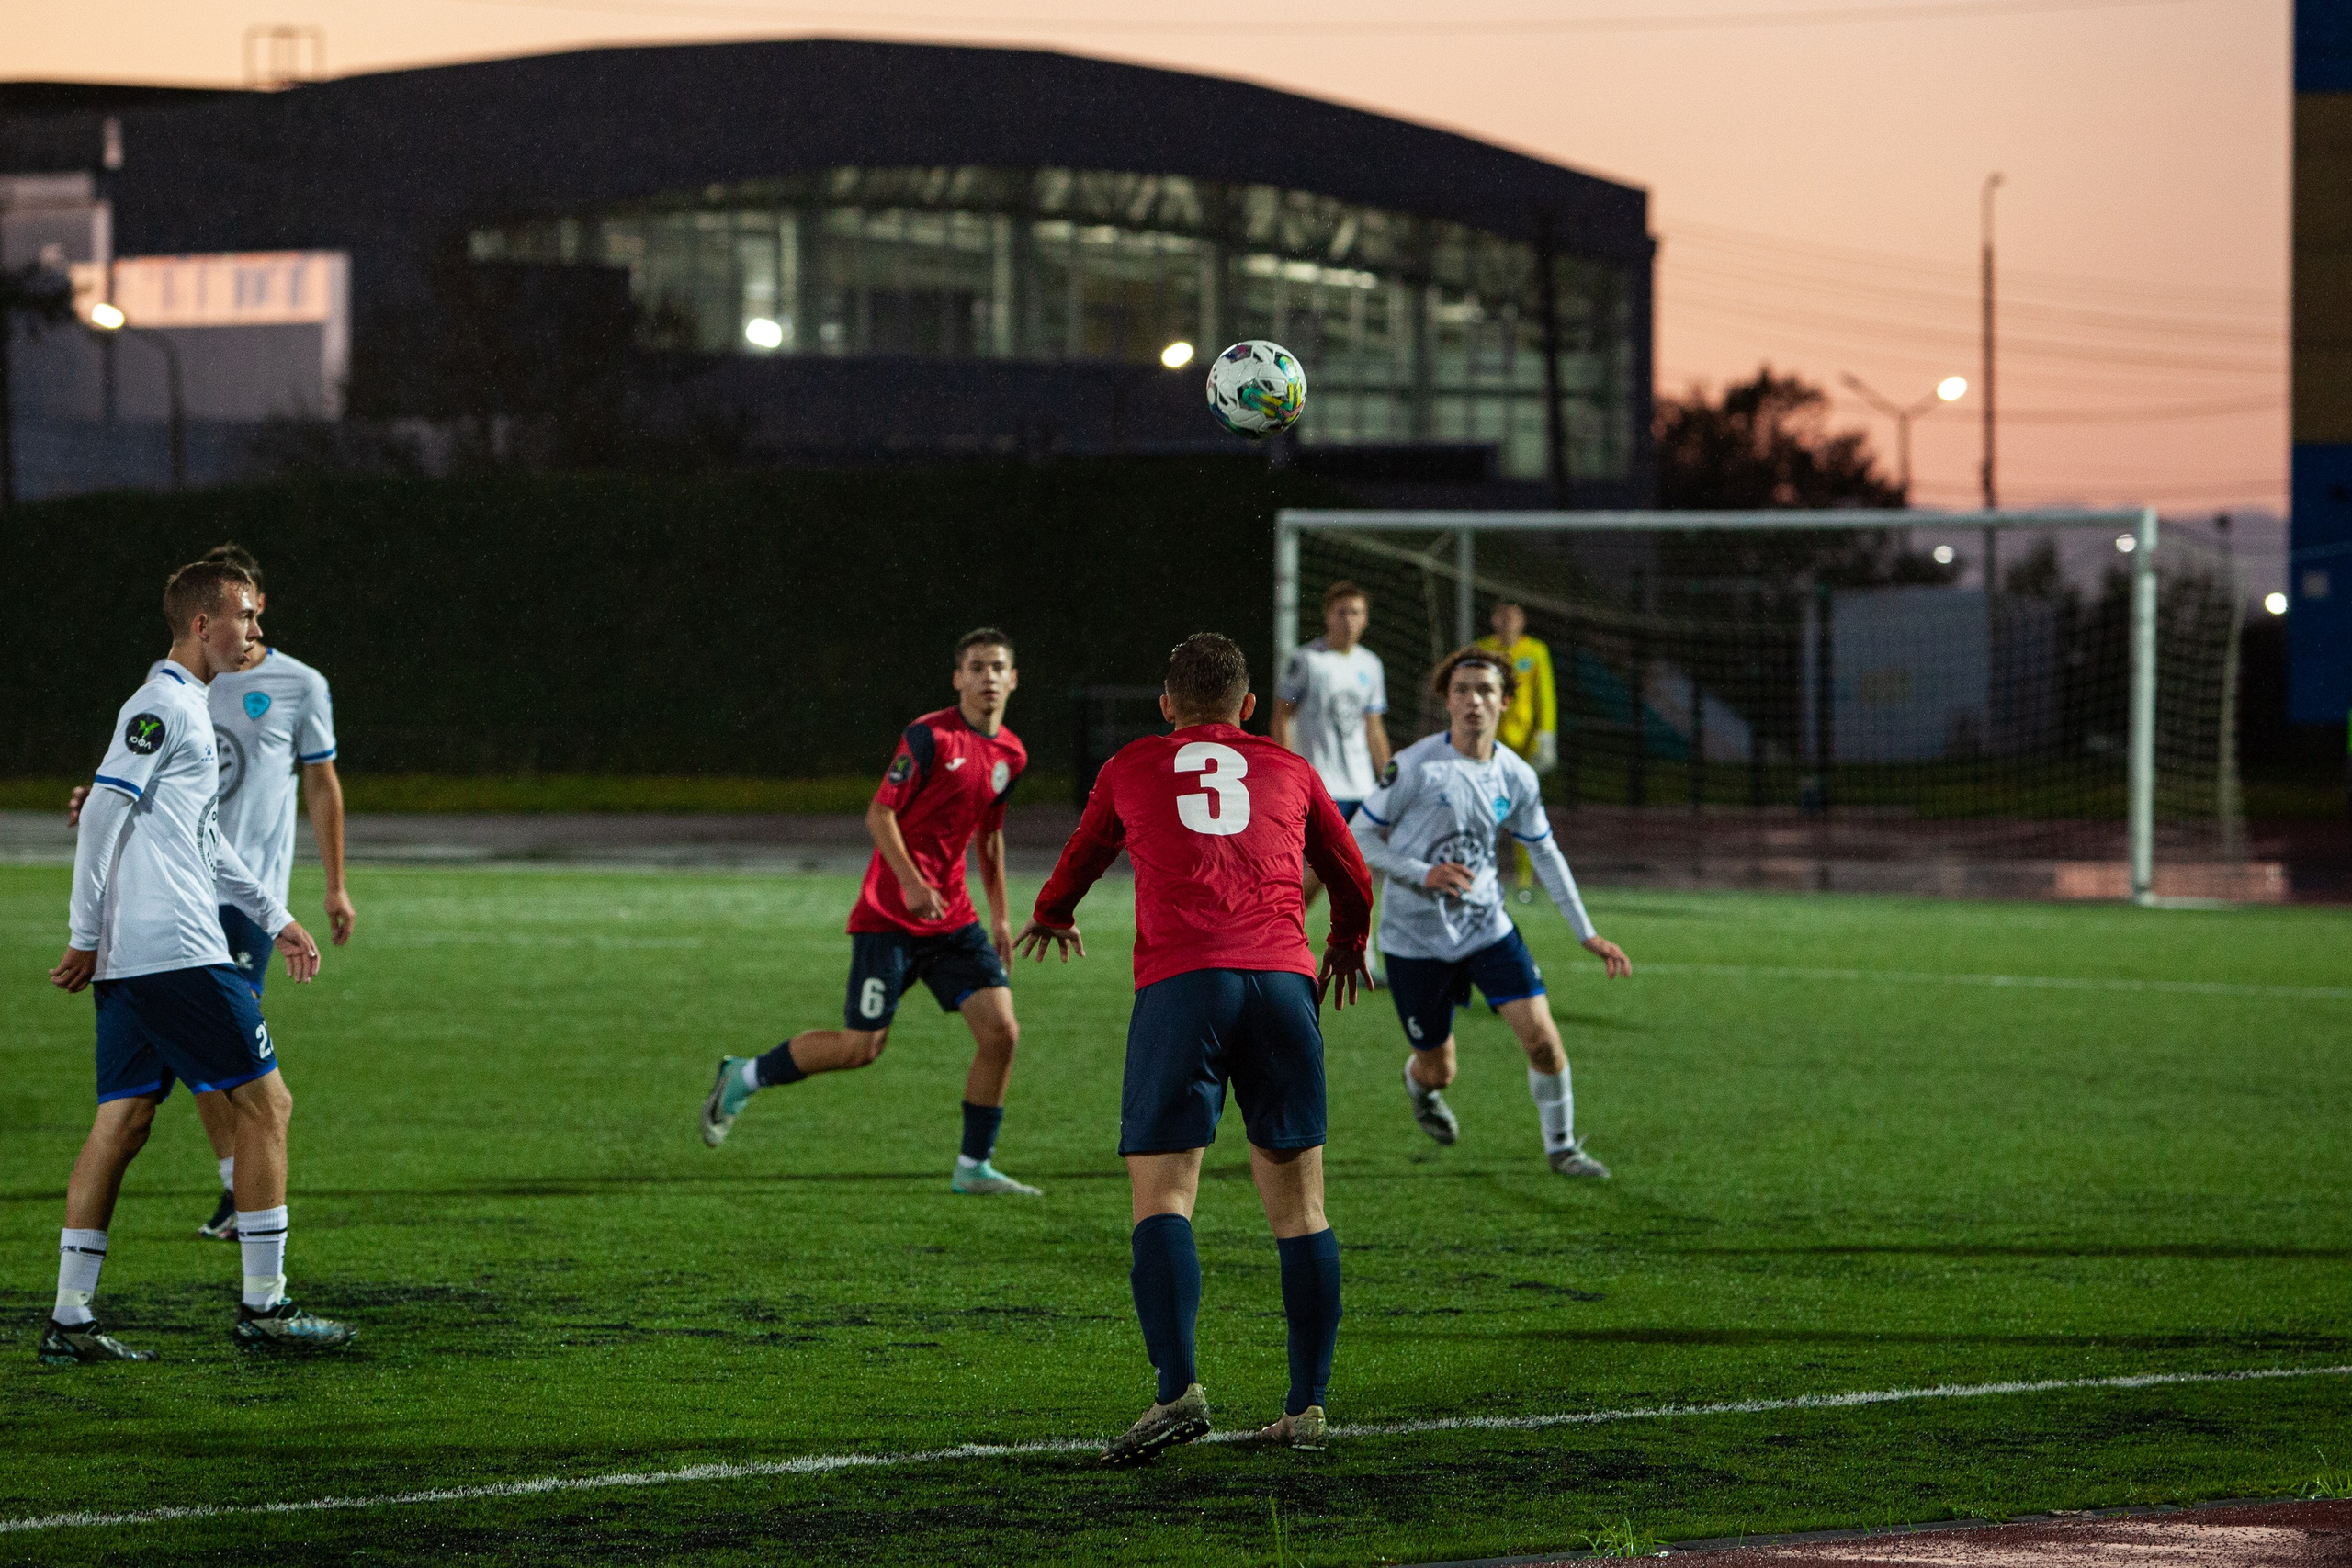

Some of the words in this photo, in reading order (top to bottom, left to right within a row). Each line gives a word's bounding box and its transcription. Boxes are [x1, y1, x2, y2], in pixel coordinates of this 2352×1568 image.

[129, 736, 152, 750] ЮФЛ
[1174, 741, 1250, 836] 3
[859, 976, 886, 1020] 6
[255, 1021, 274, 1059] 2
[1407, 1015, 1424, 1040] 6
